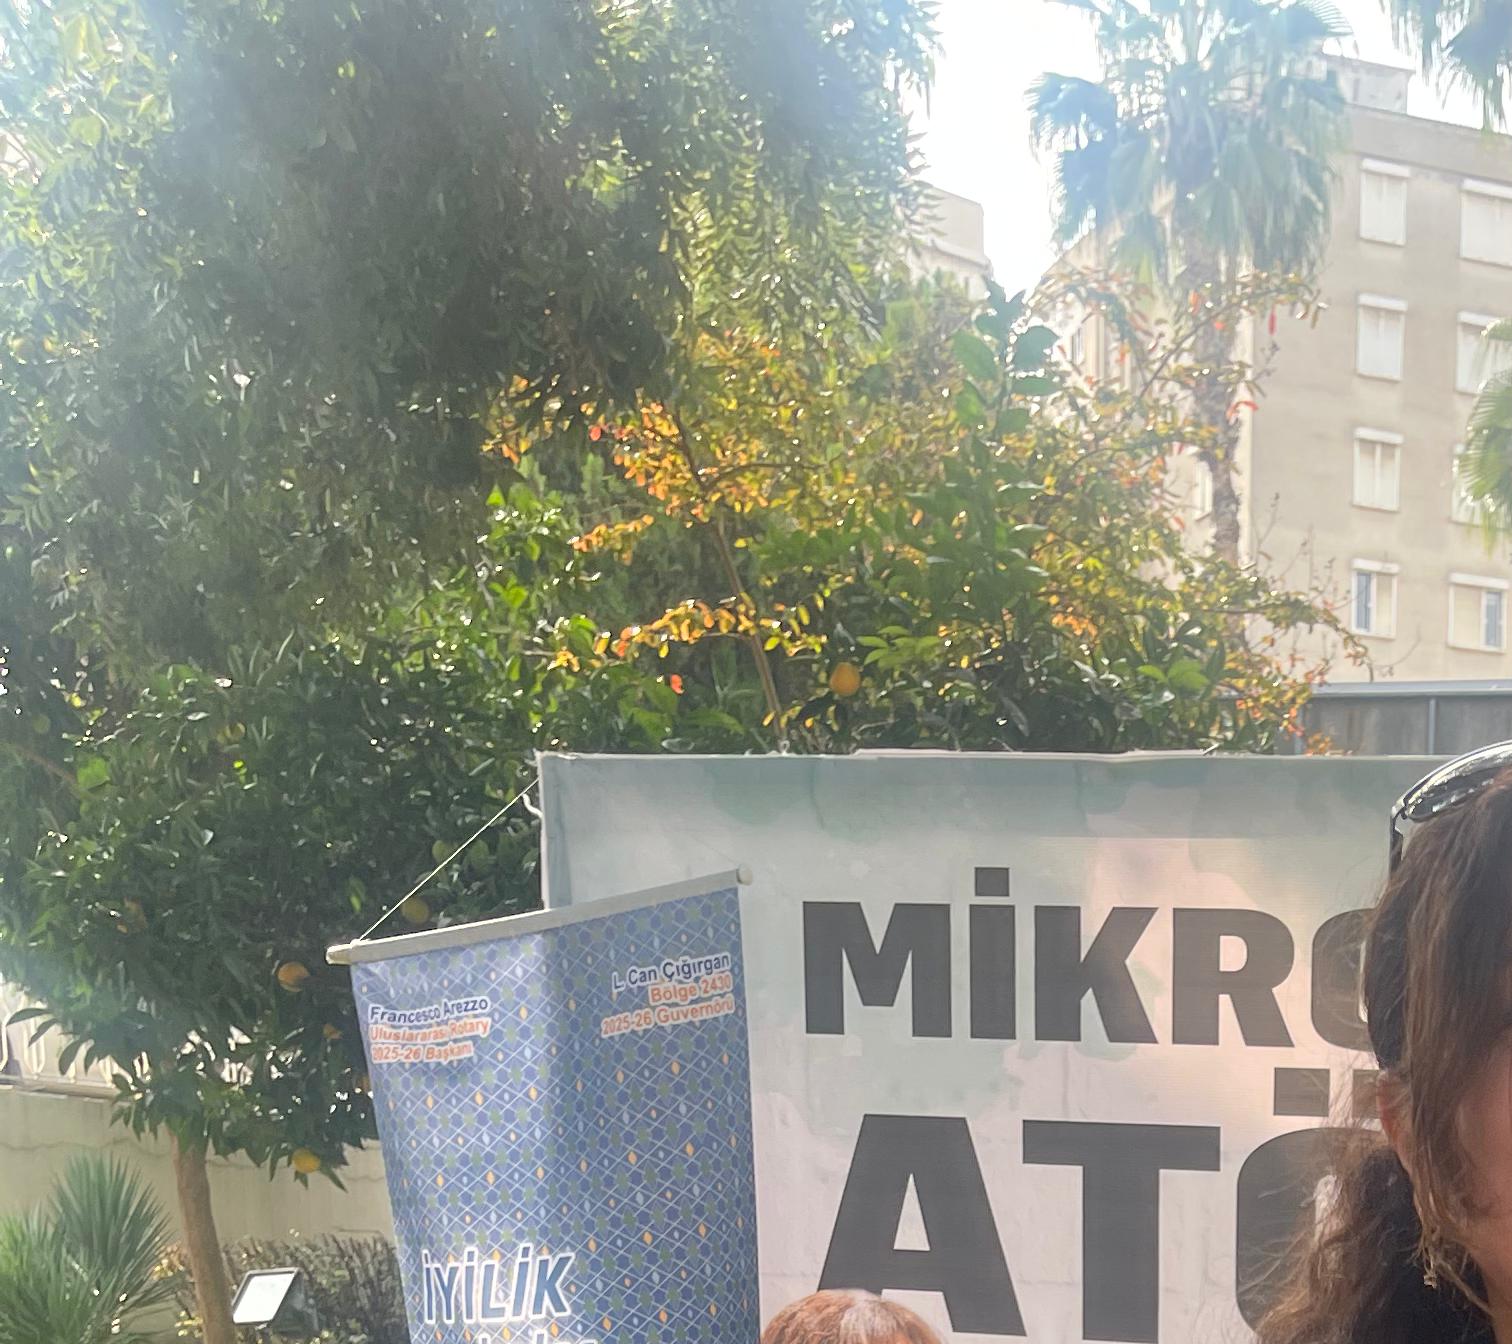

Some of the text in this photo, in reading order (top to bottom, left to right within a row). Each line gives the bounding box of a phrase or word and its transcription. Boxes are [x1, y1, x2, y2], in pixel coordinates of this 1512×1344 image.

[628, 966, 658, 984] Can
[650, 974, 733, 1004] Bölge 2430
[369, 998, 489, 1024] Francesco Arezzo
[602, 1011, 652, 1036] 2025-26
[450, 1018, 491, 1040] Rotary
[371, 1044, 421, 1063] 2025-26
[422, 1244, 575, 1325] İYİLİK
